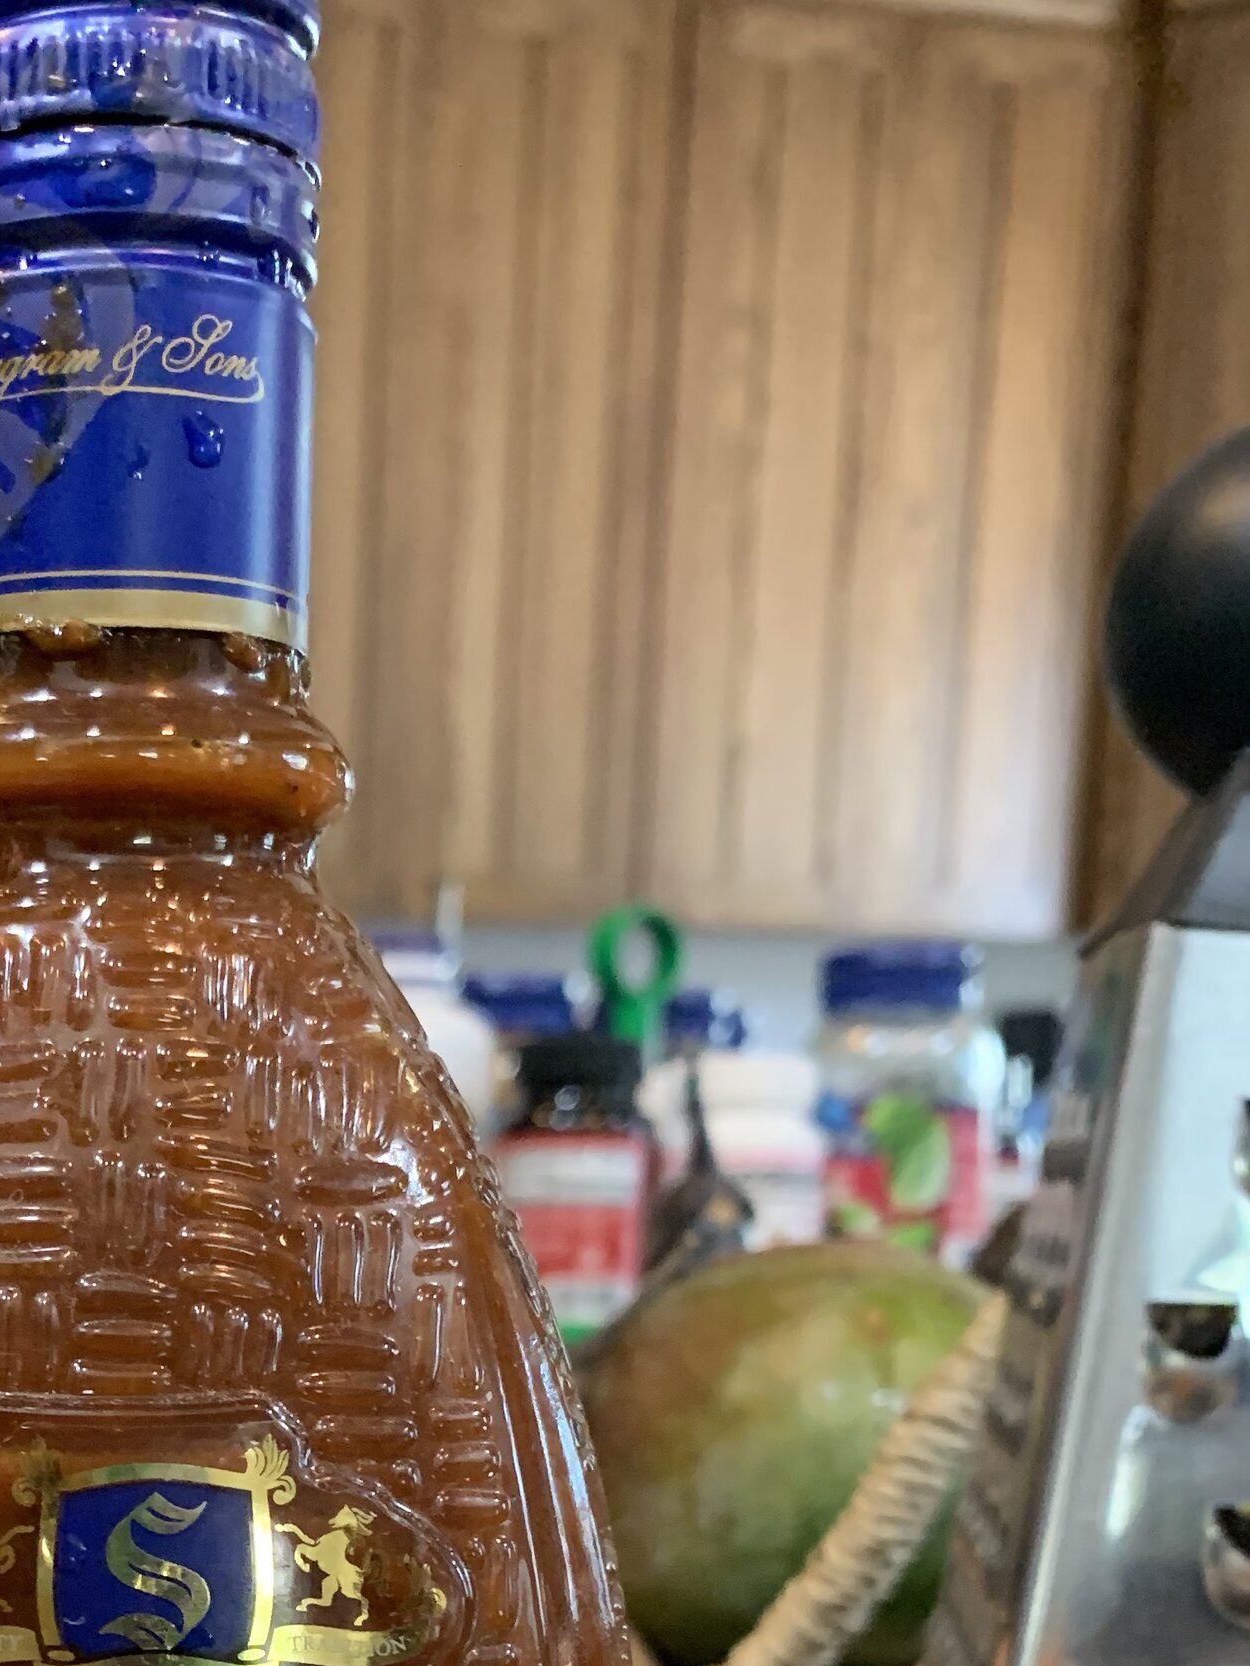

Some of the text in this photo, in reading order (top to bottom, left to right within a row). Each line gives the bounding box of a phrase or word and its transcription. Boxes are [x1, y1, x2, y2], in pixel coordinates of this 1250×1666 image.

[102, 324, 163, 395] &
[162, 314, 264, 388] Sons
[98, 1491, 211, 1652] S
